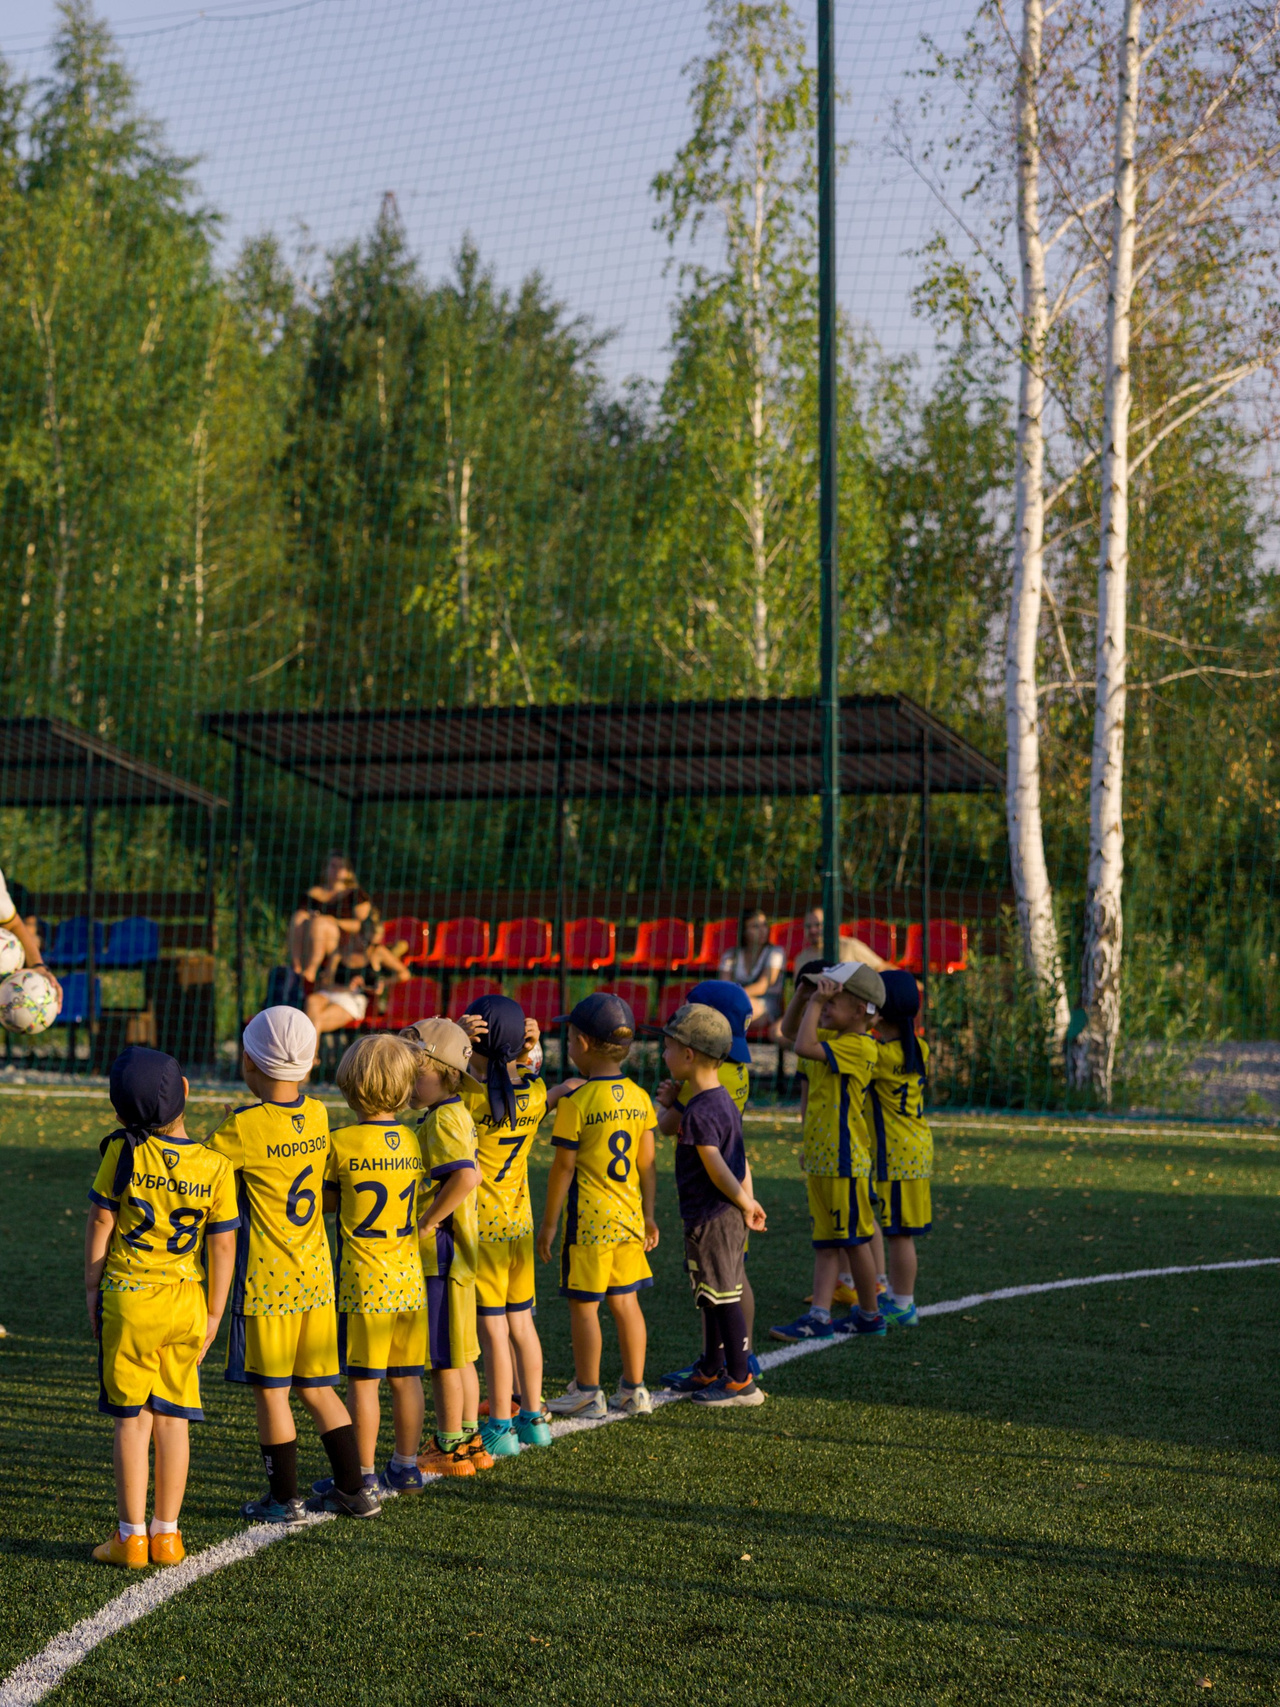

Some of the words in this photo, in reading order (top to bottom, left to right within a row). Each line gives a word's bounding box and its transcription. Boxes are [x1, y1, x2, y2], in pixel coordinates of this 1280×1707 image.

[266, 1135, 327, 1158] МОРОЗОВ
[494, 1135, 528, 1183] 7
[606, 1130, 632, 1183] 8
[286, 1164, 316, 1227] 6
[352, 1179, 417, 1239] 21
[121, 1196, 204, 1255] 28
[264, 1455, 274, 1475] FILA
